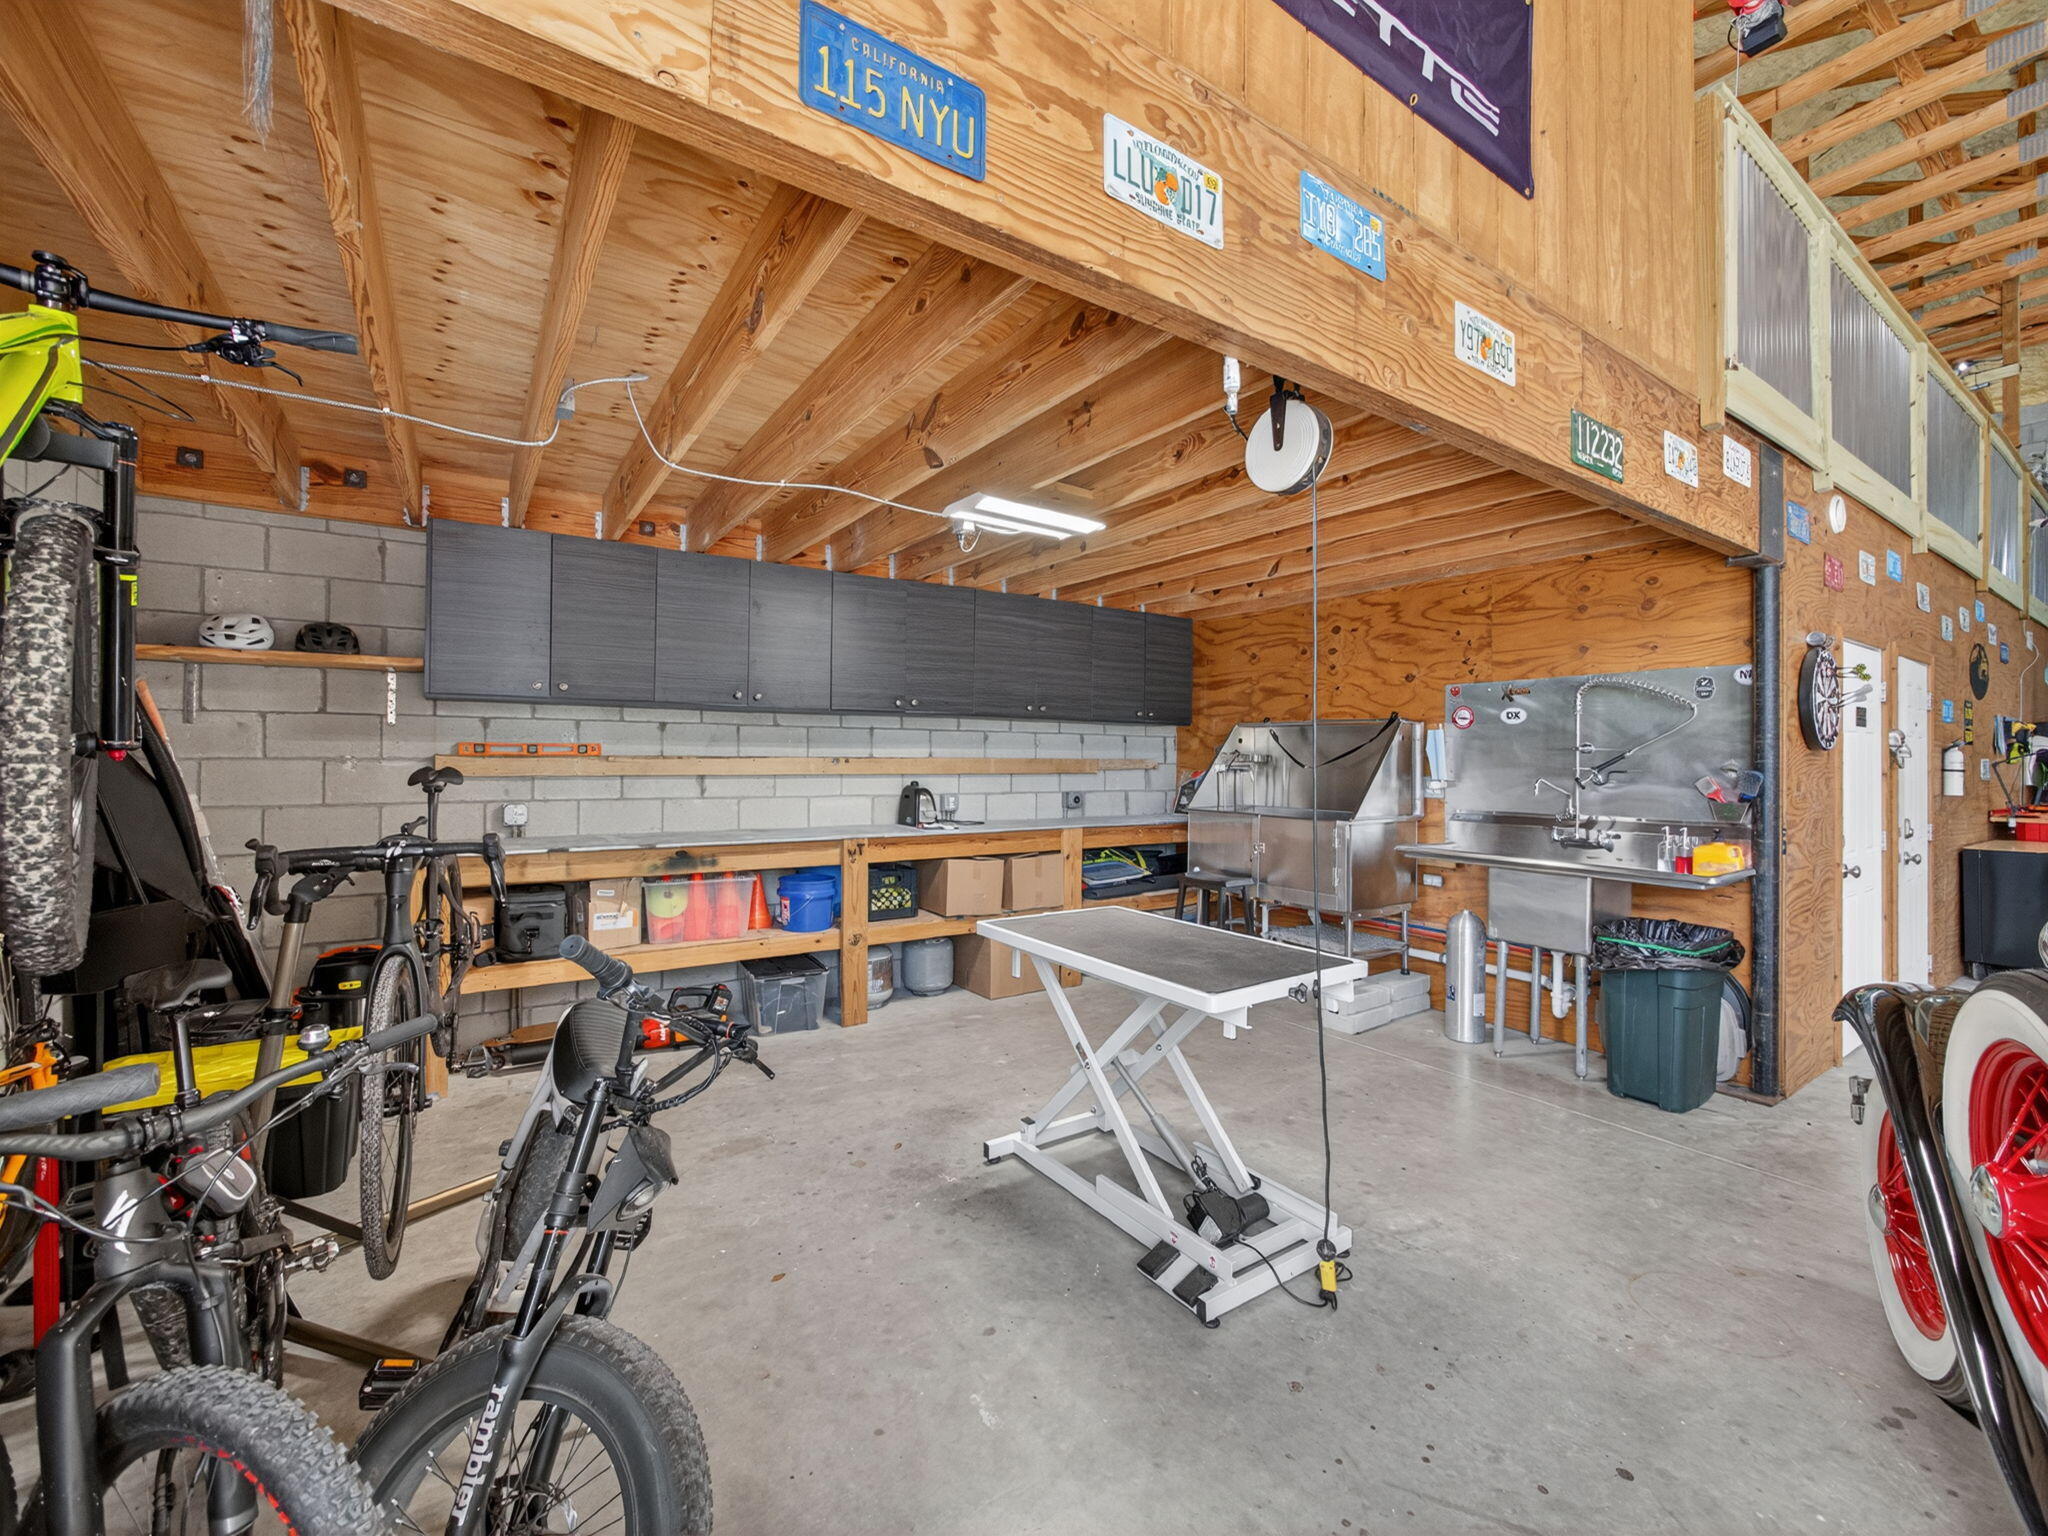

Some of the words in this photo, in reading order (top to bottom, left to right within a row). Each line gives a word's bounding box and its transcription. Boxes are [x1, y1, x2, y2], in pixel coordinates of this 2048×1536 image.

[813, 45, 886, 119] 115
[900, 85, 975, 160] NYU
[850, 36, 946, 95] CALIFORNIA
[1332, 0, 1500, 137] TTE
[450, 1383, 510, 1527] rambler
